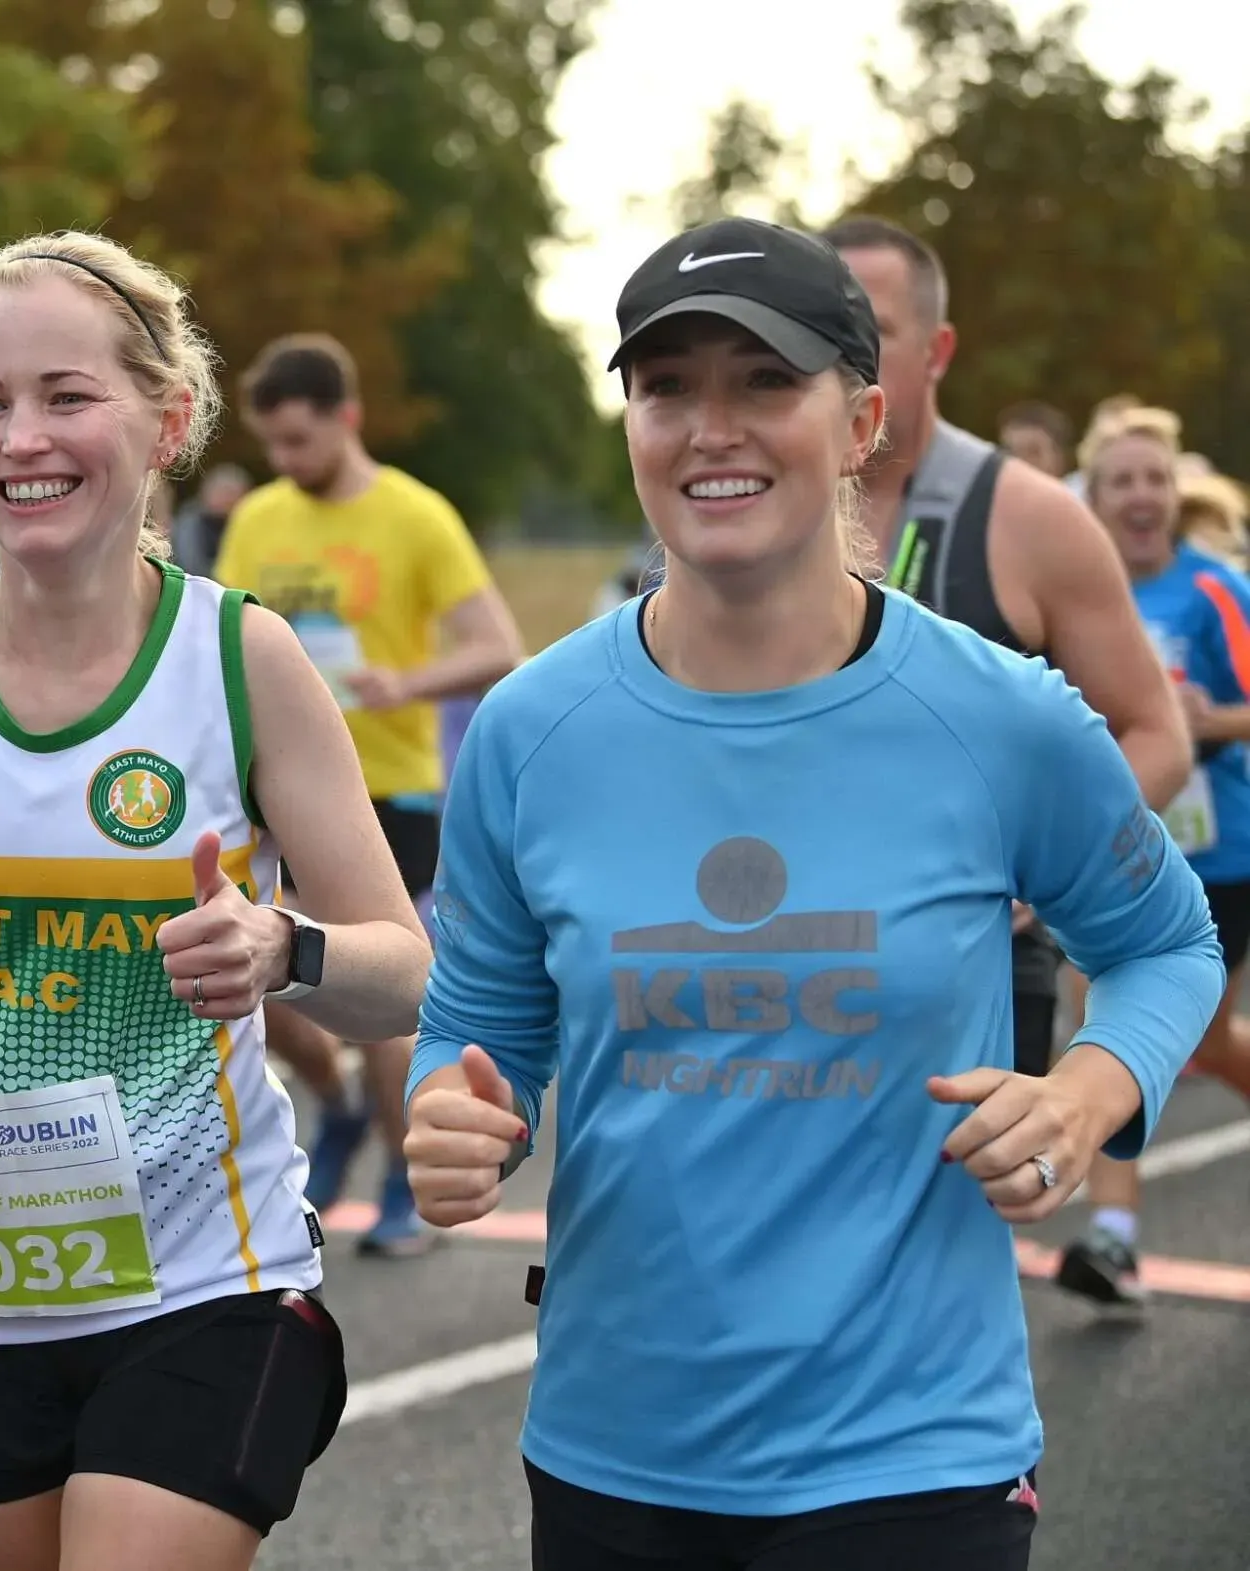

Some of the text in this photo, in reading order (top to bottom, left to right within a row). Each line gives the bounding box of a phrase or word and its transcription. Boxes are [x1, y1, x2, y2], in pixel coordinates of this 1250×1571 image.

[109, 757, 168, 773] EAST MAYO
[112, 827, 166, 843] ATHLETICS
[36, 909, 172, 954] MAY
[611, 966, 880, 1035] KBC
[622, 1049, 881, 1099] NIGHTRUN
[0, 1137, 100, 1158] RACE SERIES 2022
[8, 1183, 123, 1210] MARATHON
